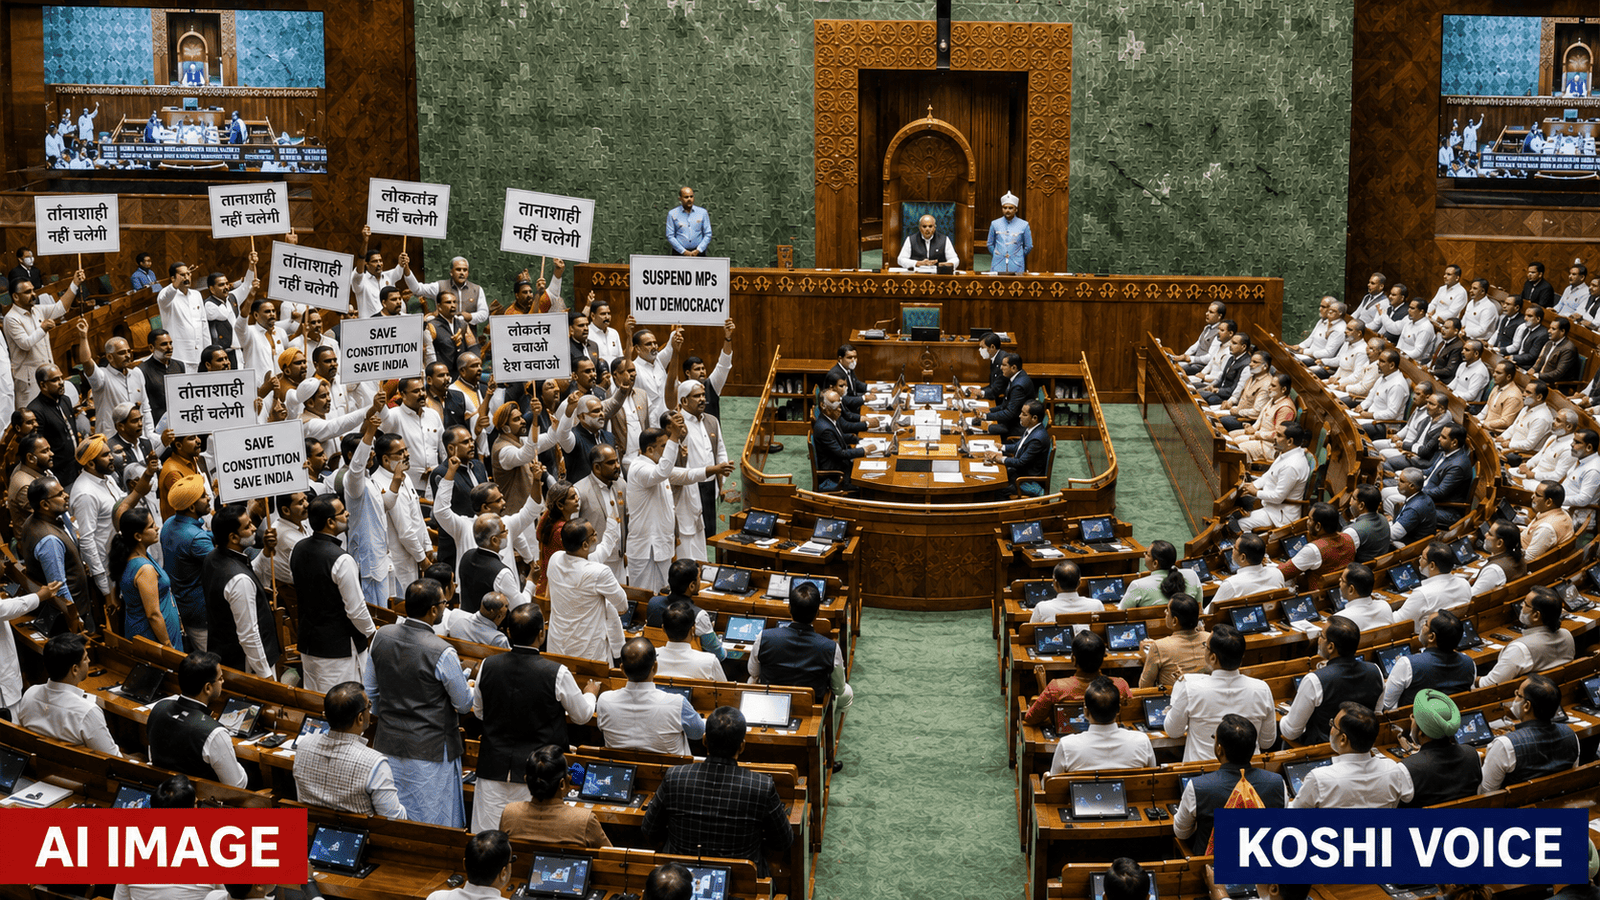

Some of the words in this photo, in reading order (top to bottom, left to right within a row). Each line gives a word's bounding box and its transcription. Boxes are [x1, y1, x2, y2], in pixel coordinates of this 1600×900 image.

[220, 188, 276, 206] तानाशाही
[220, 211, 242, 227] नहीं
[245, 208, 280, 224] चलेगी
[376, 207, 399, 224] नहीं
[402, 209, 438, 226] चलेगी
[519, 202, 581, 225] तानाशाही
[48, 226, 70, 244] नहीं
[73, 225, 107, 241] चलेगी
[513, 224, 538, 242] नहीं
[541, 227, 581, 248] चलेगी
[278, 274, 301, 292] नहीं
[304, 279, 339, 298] चलेगी
[643, 270, 692, 285] SUSPEND
[696, 271, 717, 286] MPs
[636, 297, 657, 311] NOT
[660, 297, 724, 312] DEMOCRACY
[370, 327, 396, 340] SAVE
[347, 342, 417, 358] CONSTITUTION
[354, 361, 379, 373] SAVE
[383, 359, 408, 370] INDIA
[179, 405, 204, 423] नहीं
[207, 402, 244, 419] चलेगी
[245, 436, 274, 451] SAVE
[223, 452, 300, 473] CONSTITUTION
[234, 475, 262, 489] SAVE
[264, 471, 293, 485] INDIA
